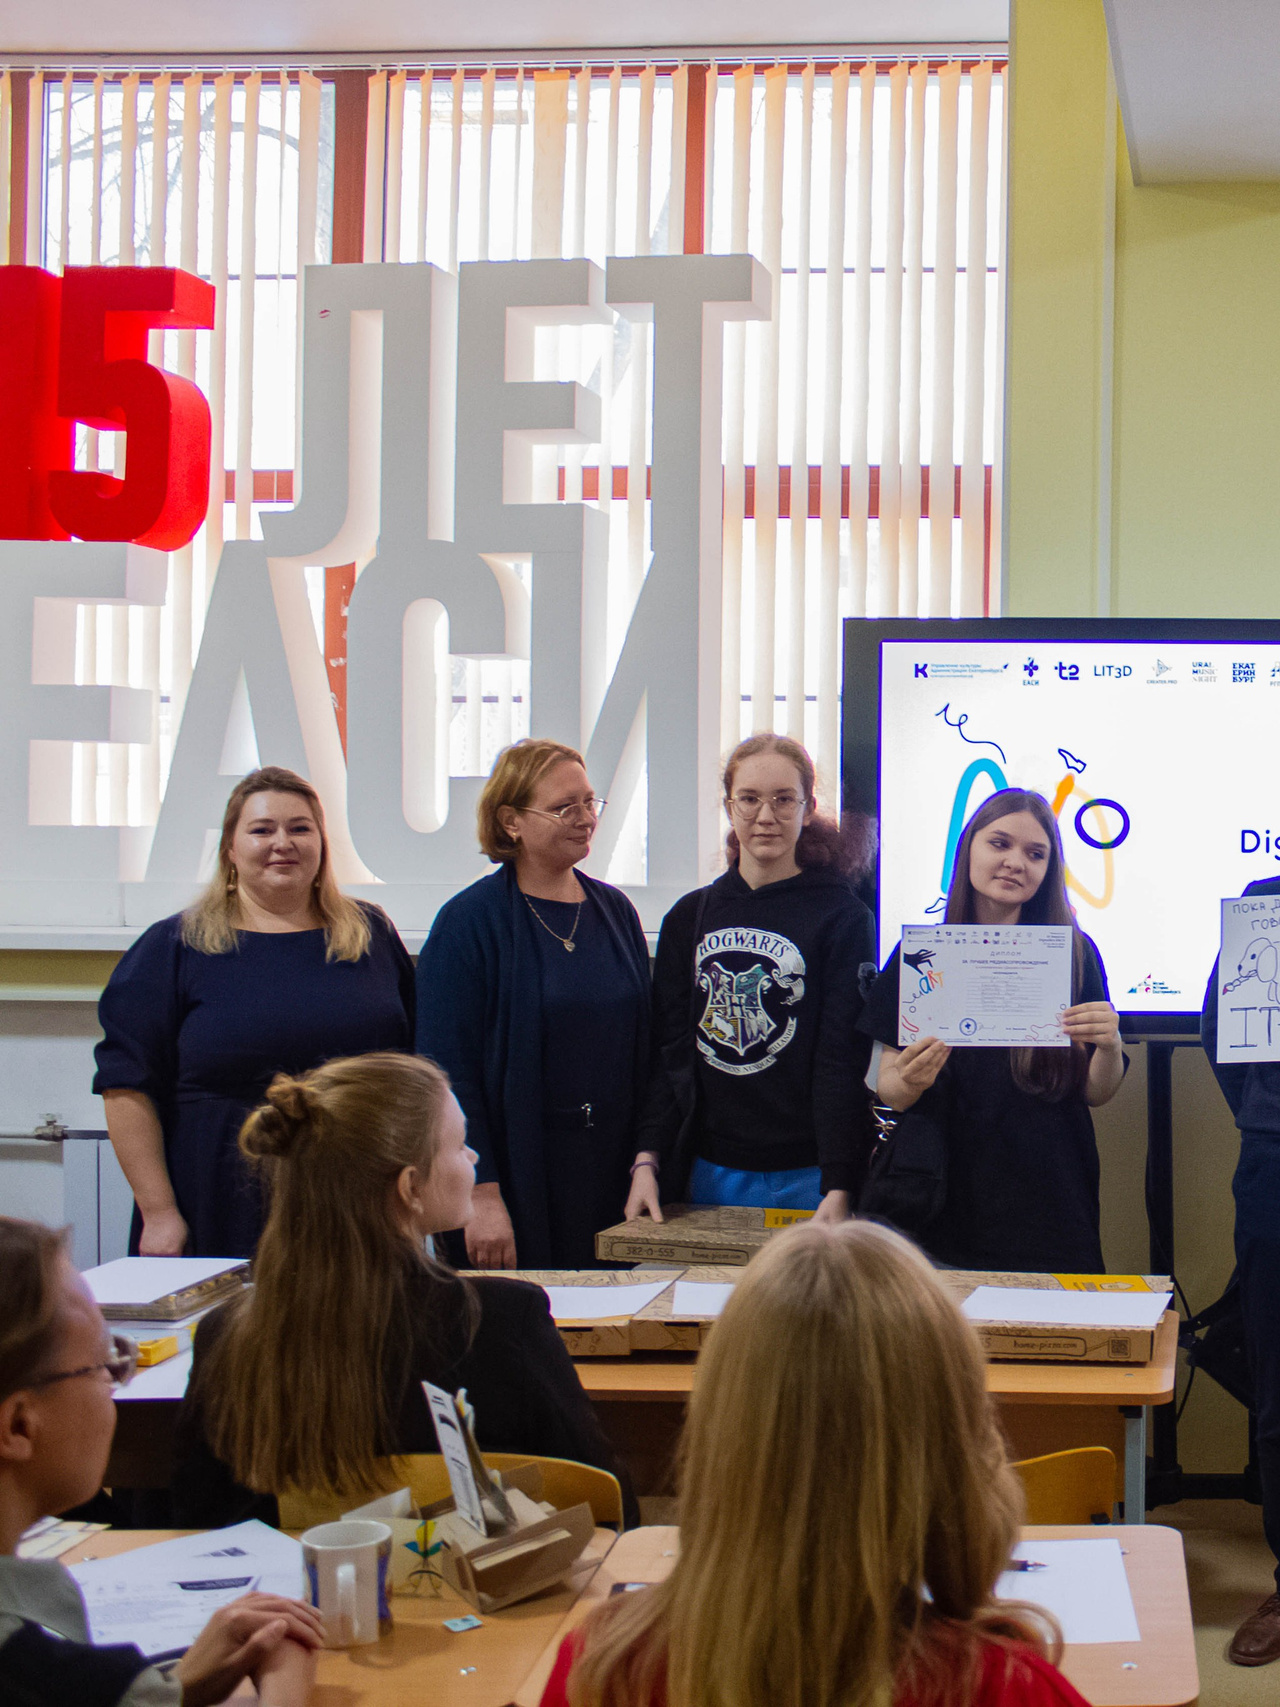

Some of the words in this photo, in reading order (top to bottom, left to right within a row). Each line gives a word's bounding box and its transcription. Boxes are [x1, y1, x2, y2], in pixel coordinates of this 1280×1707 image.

[260, 254, 772, 566] ЛЕТ
[1094, 665, 1133, 678] LIT3D
[1232, 662, 1256, 670] ЕКАТ
[1232, 669, 1256, 677] ЕРИН
[0, 540, 721, 886] ЕАСИ
[1232, 902, 1266, 914] ПОКА
[698, 931, 791, 957] HOGWARTS
[626, 1246, 675, 1258] 382-0-555
[1013, 1340, 1078, 1351] home-pizza.com
